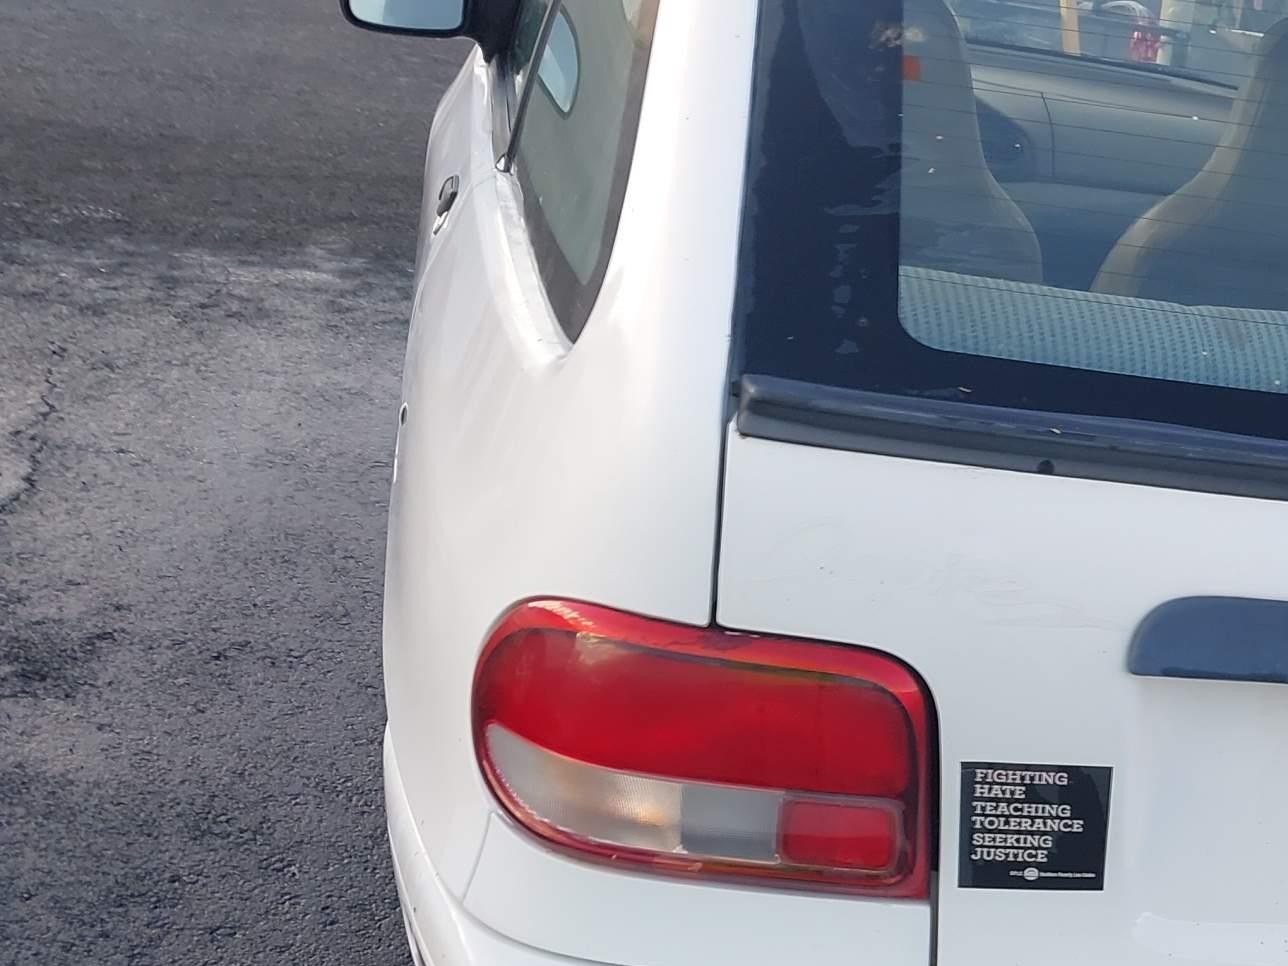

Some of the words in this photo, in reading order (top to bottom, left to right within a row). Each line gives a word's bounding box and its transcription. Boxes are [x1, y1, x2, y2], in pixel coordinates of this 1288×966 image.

[974, 769, 1068, 785] FIGHTING
[973, 785, 1026, 798] HATE
[972, 802, 1071, 817] TEACHING
[970, 816, 1084, 833] TOLERANCE
[972, 832, 1053, 848] SEEKING
[970, 847, 1048, 863] JUSTICE
